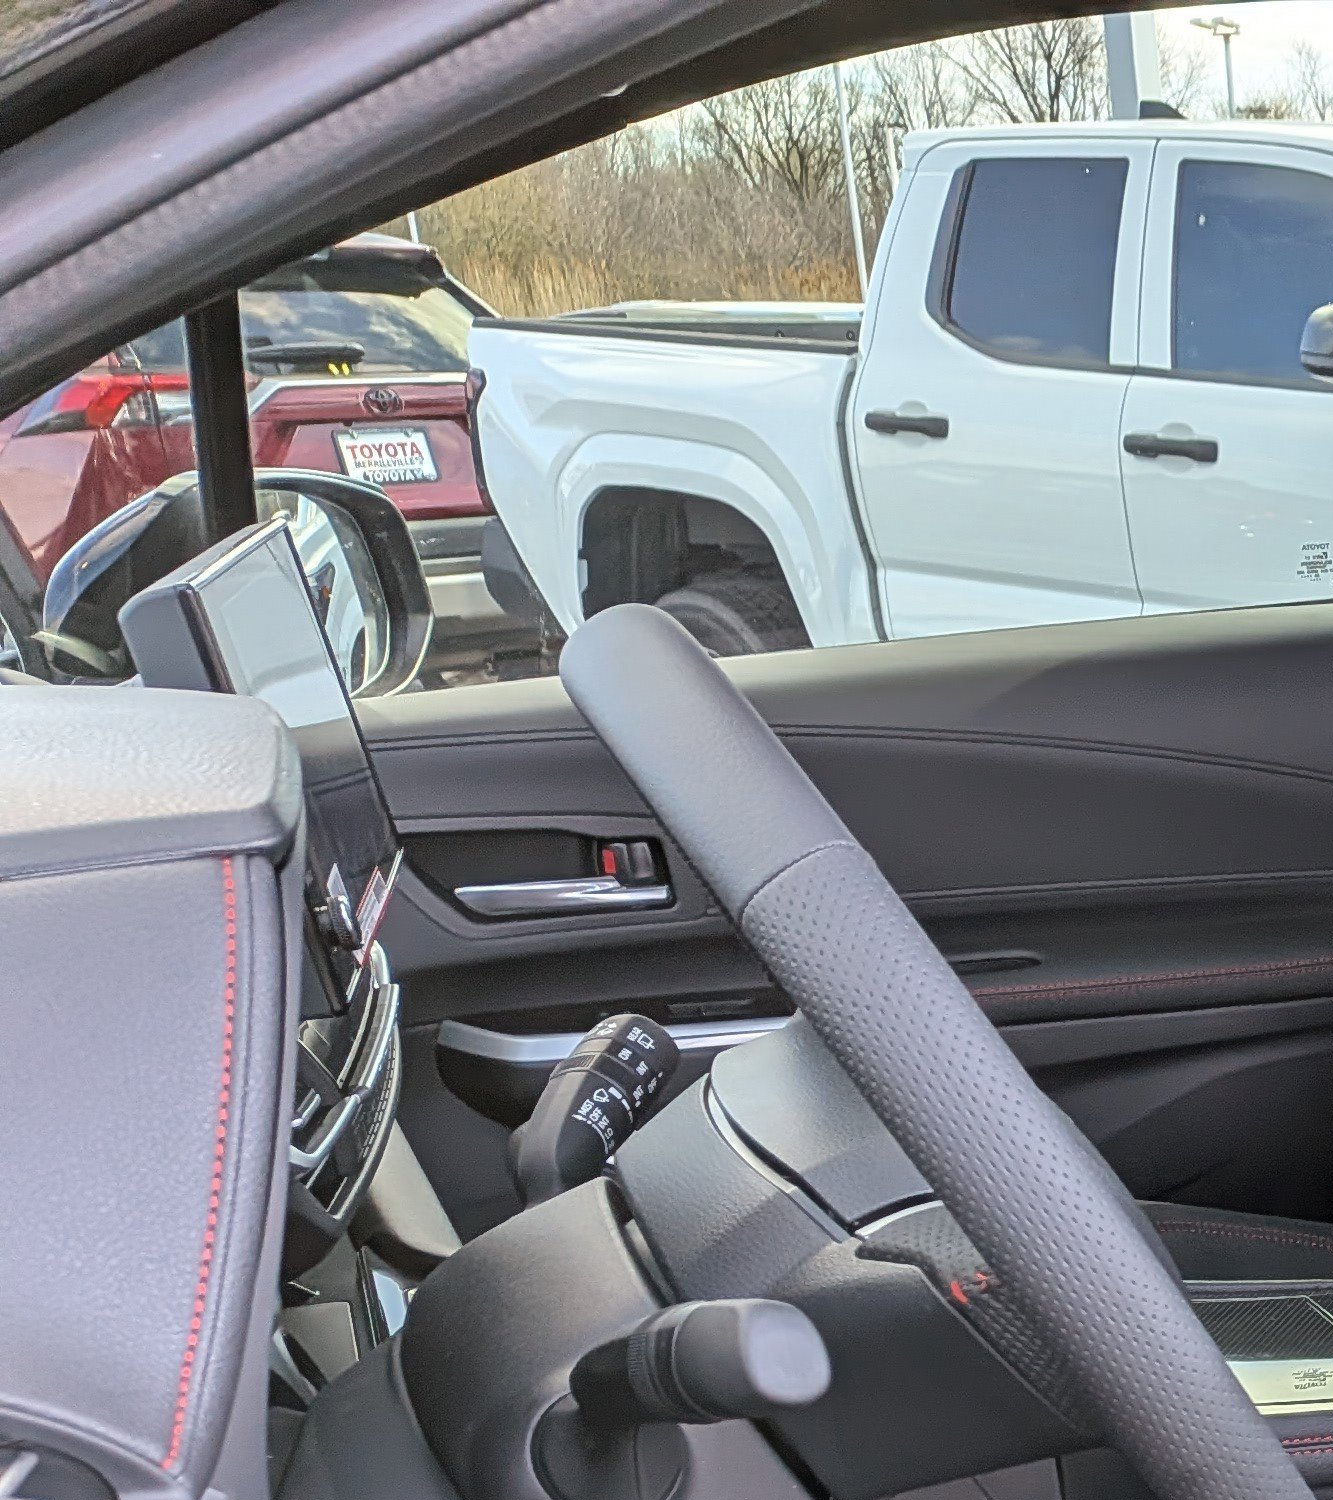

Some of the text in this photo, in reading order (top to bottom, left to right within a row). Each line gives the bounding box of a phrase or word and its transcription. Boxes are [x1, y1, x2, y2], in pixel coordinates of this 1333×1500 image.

[346, 442, 423, 460] TOYOTA
[369, 468, 414, 483] TOYOTA
[617, 1048, 633, 1060] ON
[635, 1060, 649, 1076] INT
[632, 1084, 645, 1101] INT
[577, 1098, 595, 1116] MIST
[588, 1107, 603, 1122] OFF
[597, 1115, 611, 1130] INT
